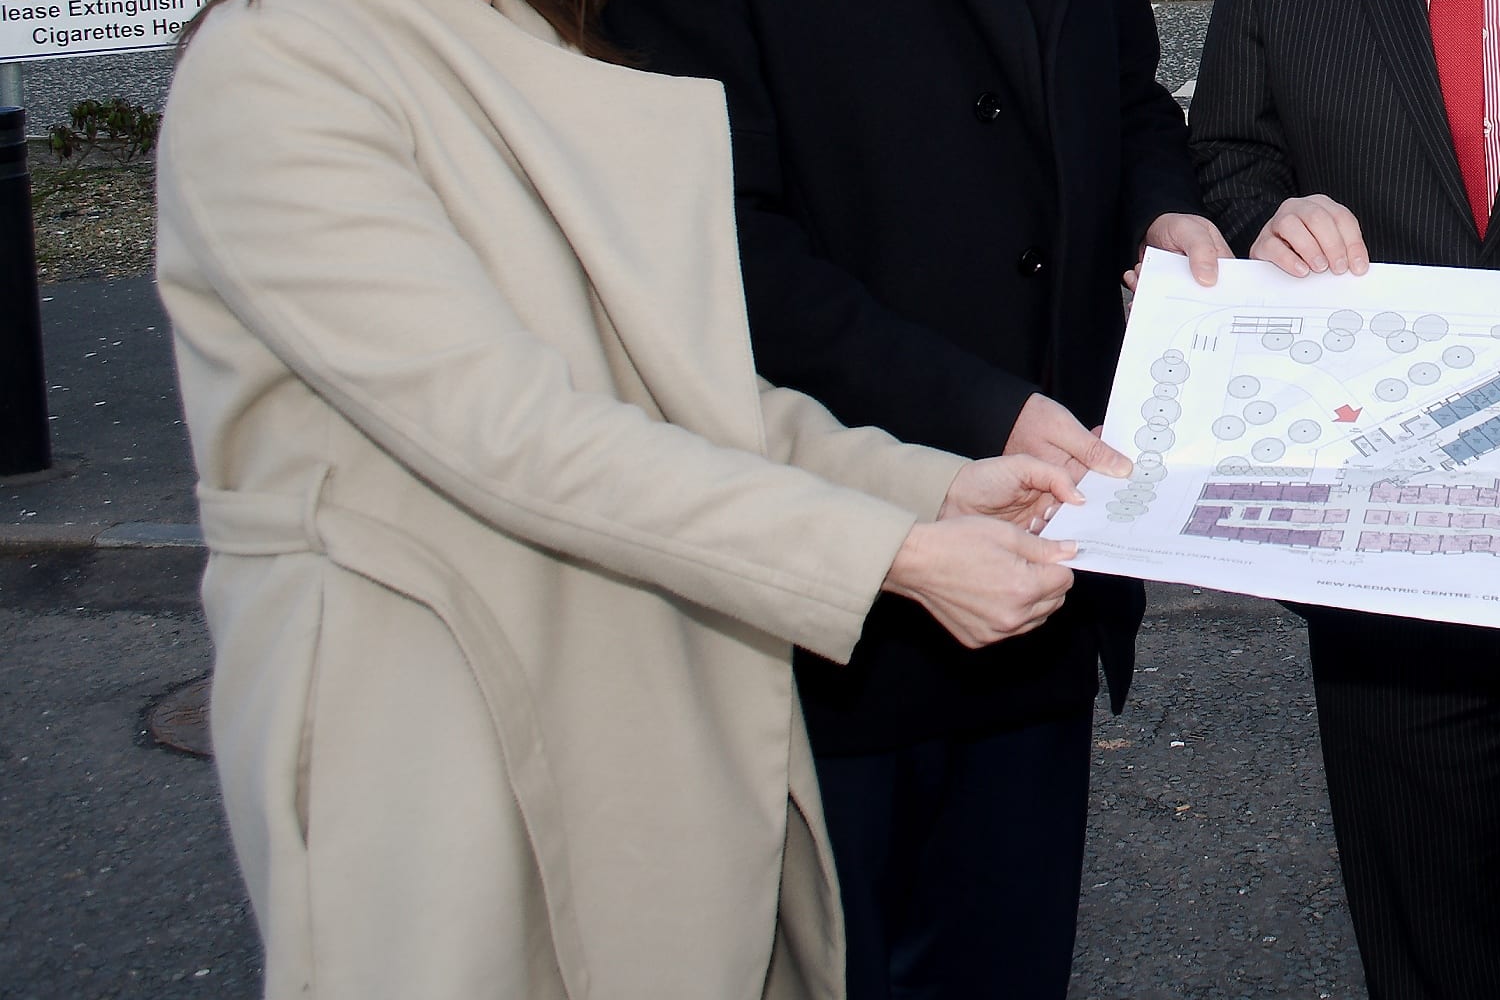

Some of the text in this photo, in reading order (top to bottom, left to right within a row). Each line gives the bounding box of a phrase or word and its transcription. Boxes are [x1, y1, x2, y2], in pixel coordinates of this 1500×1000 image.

[2, 4, 60, 22] lease
[32, 18, 191, 47] Cigarettes Her
[1316, 579, 1345, 588] NEW
[1348, 583, 1419, 594] PAEDIATRIC
[1422, 590, 1471, 599] CENTRE
